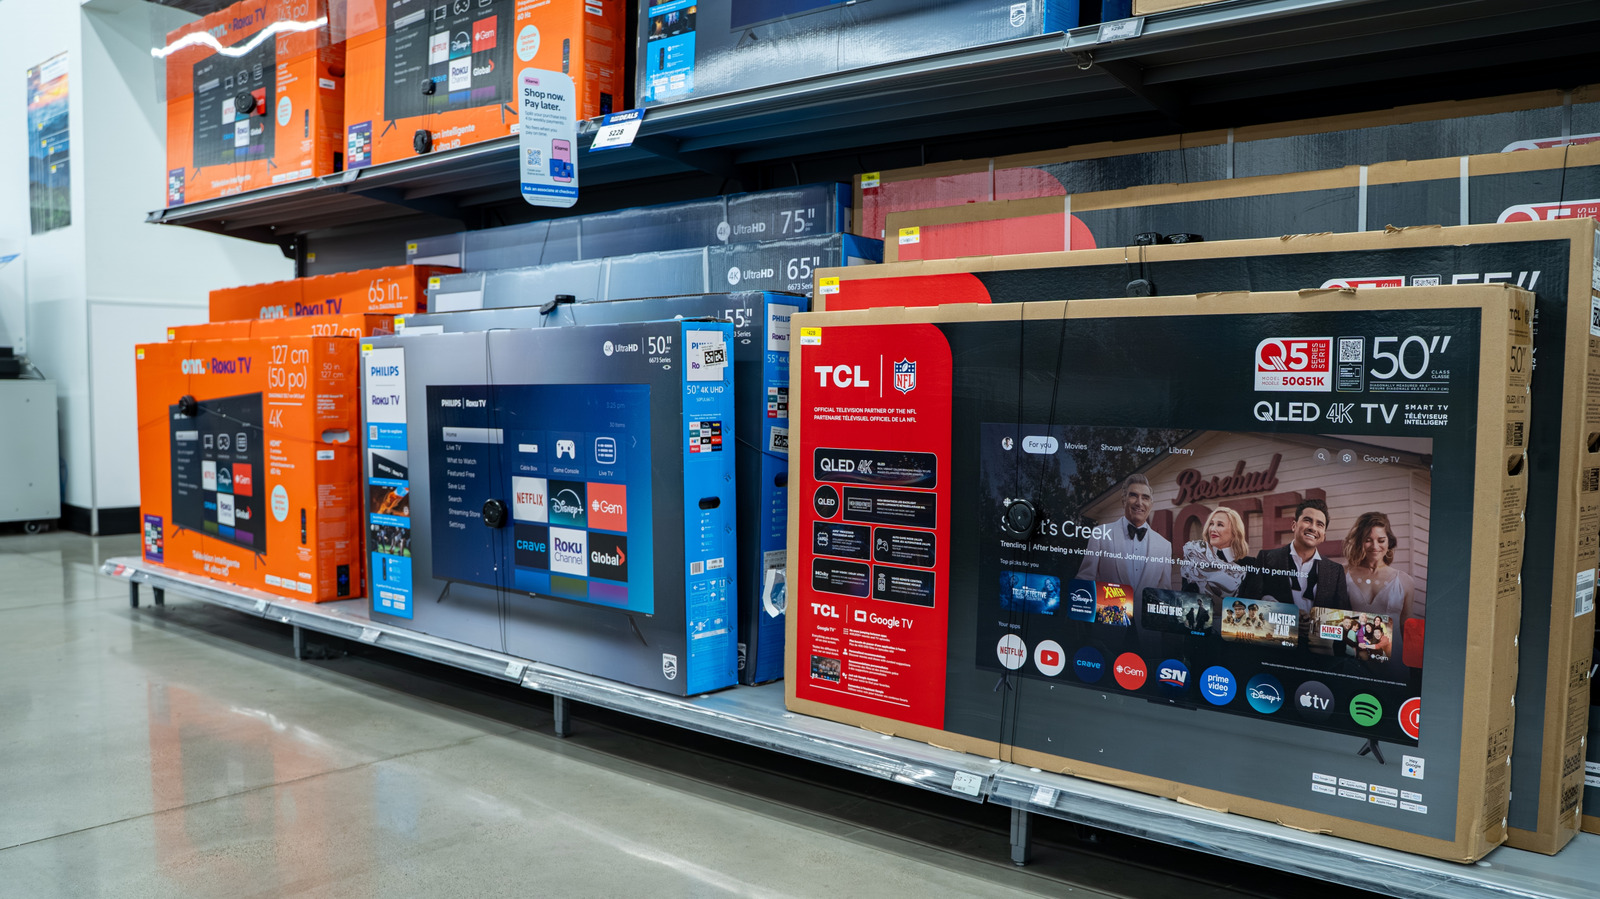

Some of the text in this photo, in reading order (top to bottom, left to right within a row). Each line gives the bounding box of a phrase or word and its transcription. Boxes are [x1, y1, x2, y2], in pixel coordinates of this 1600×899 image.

[233, 7, 266, 31] Roku TV
[480, 29, 495, 41] Gem
[277, 40, 289, 56] 4K
[452, 66, 469, 76] Roku
[473, 65, 491, 77] Global
[525, 88, 565, 101] Shop now.
[525, 99, 561, 111] Pay later.
[733, 208, 815, 235] UltraHD 75"
[743, 268, 774, 279] UltraHD
[787, 257, 820, 281] 65"
[369, 279, 385, 303] 65
[788, 283, 800, 291] 6673
[326, 299, 342, 315] TV
[1510, 309, 1521, 320] TCL
[615, 336, 672, 355] UltraHD 50"
[271, 345, 309, 364] 127 cm
[1255, 337, 1309, 370] Q5
[182, 357, 252, 375] onn. Roku TV
[371, 366, 399, 377] PHILIPS
[268, 367, 307, 392] (50 po)
[814, 364, 913, 389] TCL NFL
[1282, 377, 1324, 386] 50Q51K
[701, 386, 723, 394] 4K UHD
[372, 395, 400, 405] Roku TV
[478, 399, 486, 407] TV
[1254, 401, 1398, 424] QLED 4K TV
[1405, 412, 1448, 420] TÉLÉVISEUR
[269, 410, 283, 429] 4K
[1065, 442, 1087, 450] Movies
[1137, 446, 1154, 454] Apps
[1169, 447, 1194, 456] Library
[821, 458, 855, 473] QLED
[857, 459, 873, 474] 4K
[1364, 455, 1389, 465] Google
[447, 470, 464, 478] Featured
[1172, 453, 1283, 506] Rosebud
[517, 492, 543, 506] NETFLIX
[818, 497, 835, 506] QLED
[551, 493, 584, 519] Disney+
[600, 501, 623, 514] Gem
[449, 508, 481, 518] Streaming Store
[449, 521, 466, 530] Settings
[1062, 520, 1112, 541] Creek
[555, 538, 582, 554] Roku
[555, 552, 583, 565] Channel
[591, 551, 619, 566] Global
[1001, 540, 1027, 550] Trending
[1050, 545, 1067, 555] being
[1074, 548, 1094, 556] victim
[1104, 551, 1123, 560] fraud,
[1125, 553, 1149, 563] Johnny
[1165, 557, 1175, 565] his
[1177, 559, 1198, 568] famy
[1211, 562, 1229, 570] from
[1231, 564, 1260, 574] wealthy
[1272, 569, 1308, 578] penniless
[811, 603, 913, 629] TCL Google TV
[1147, 603, 1183, 617] THE LAST US
[1269, 613, 1296, 626] MASTERS
[1280, 626, 1290, 636] AIR
[1322, 625, 1342, 634] KIM'S
[1000, 646, 1024, 657] NETFLIX
[1376, 653, 1388, 661] Gem
[1124, 666, 1144, 677] Gem
[1160, 668, 1187, 683] SN
[1208, 674, 1229, 683] prime
[1208, 682, 1228, 692] video
[1314, 695, 1329, 710] tv
